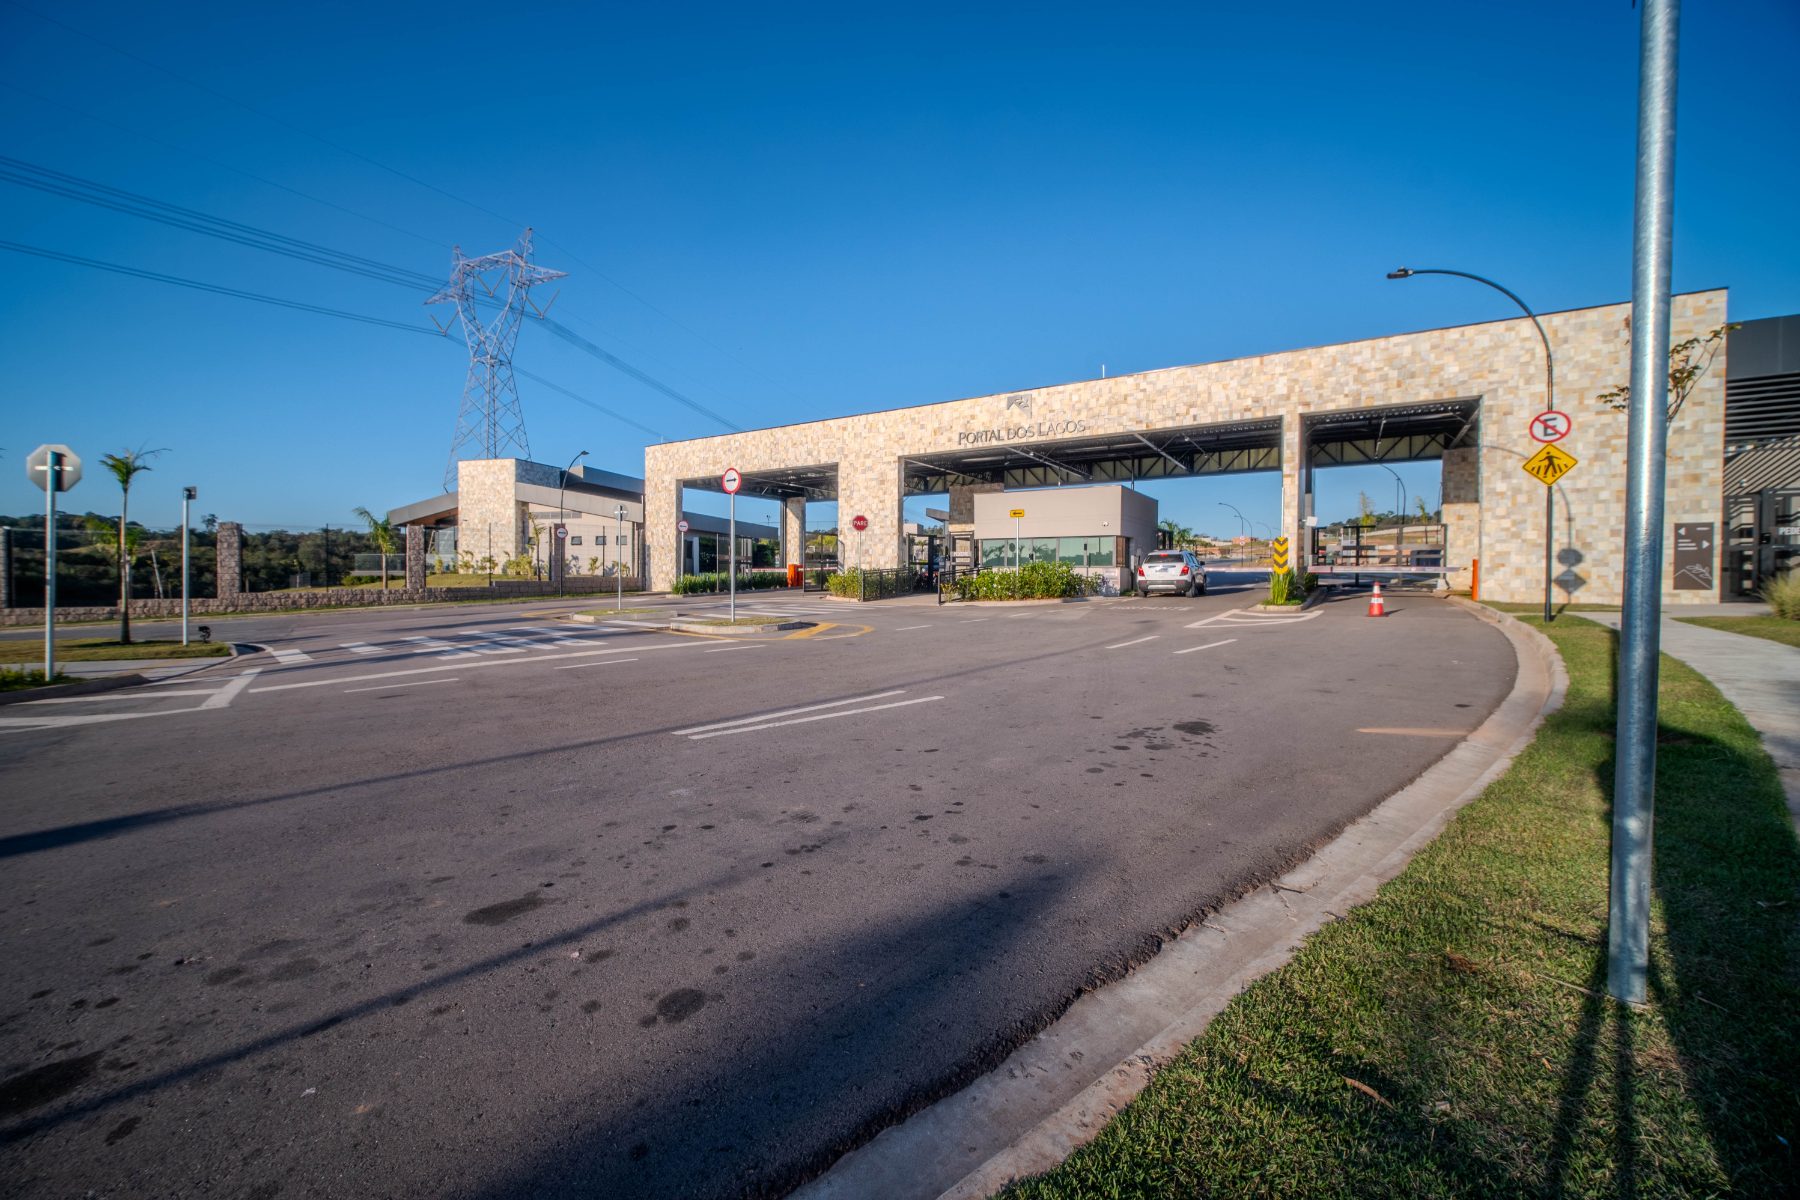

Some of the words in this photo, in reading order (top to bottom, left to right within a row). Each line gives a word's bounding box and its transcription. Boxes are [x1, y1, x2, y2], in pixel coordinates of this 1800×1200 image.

[958, 429, 1004, 446] PORTAL
[1007, 425, 1035, 441] DOS
[1037, 419, 1087, 437] LAGOS
[1543, 417, 1558, 437] E
